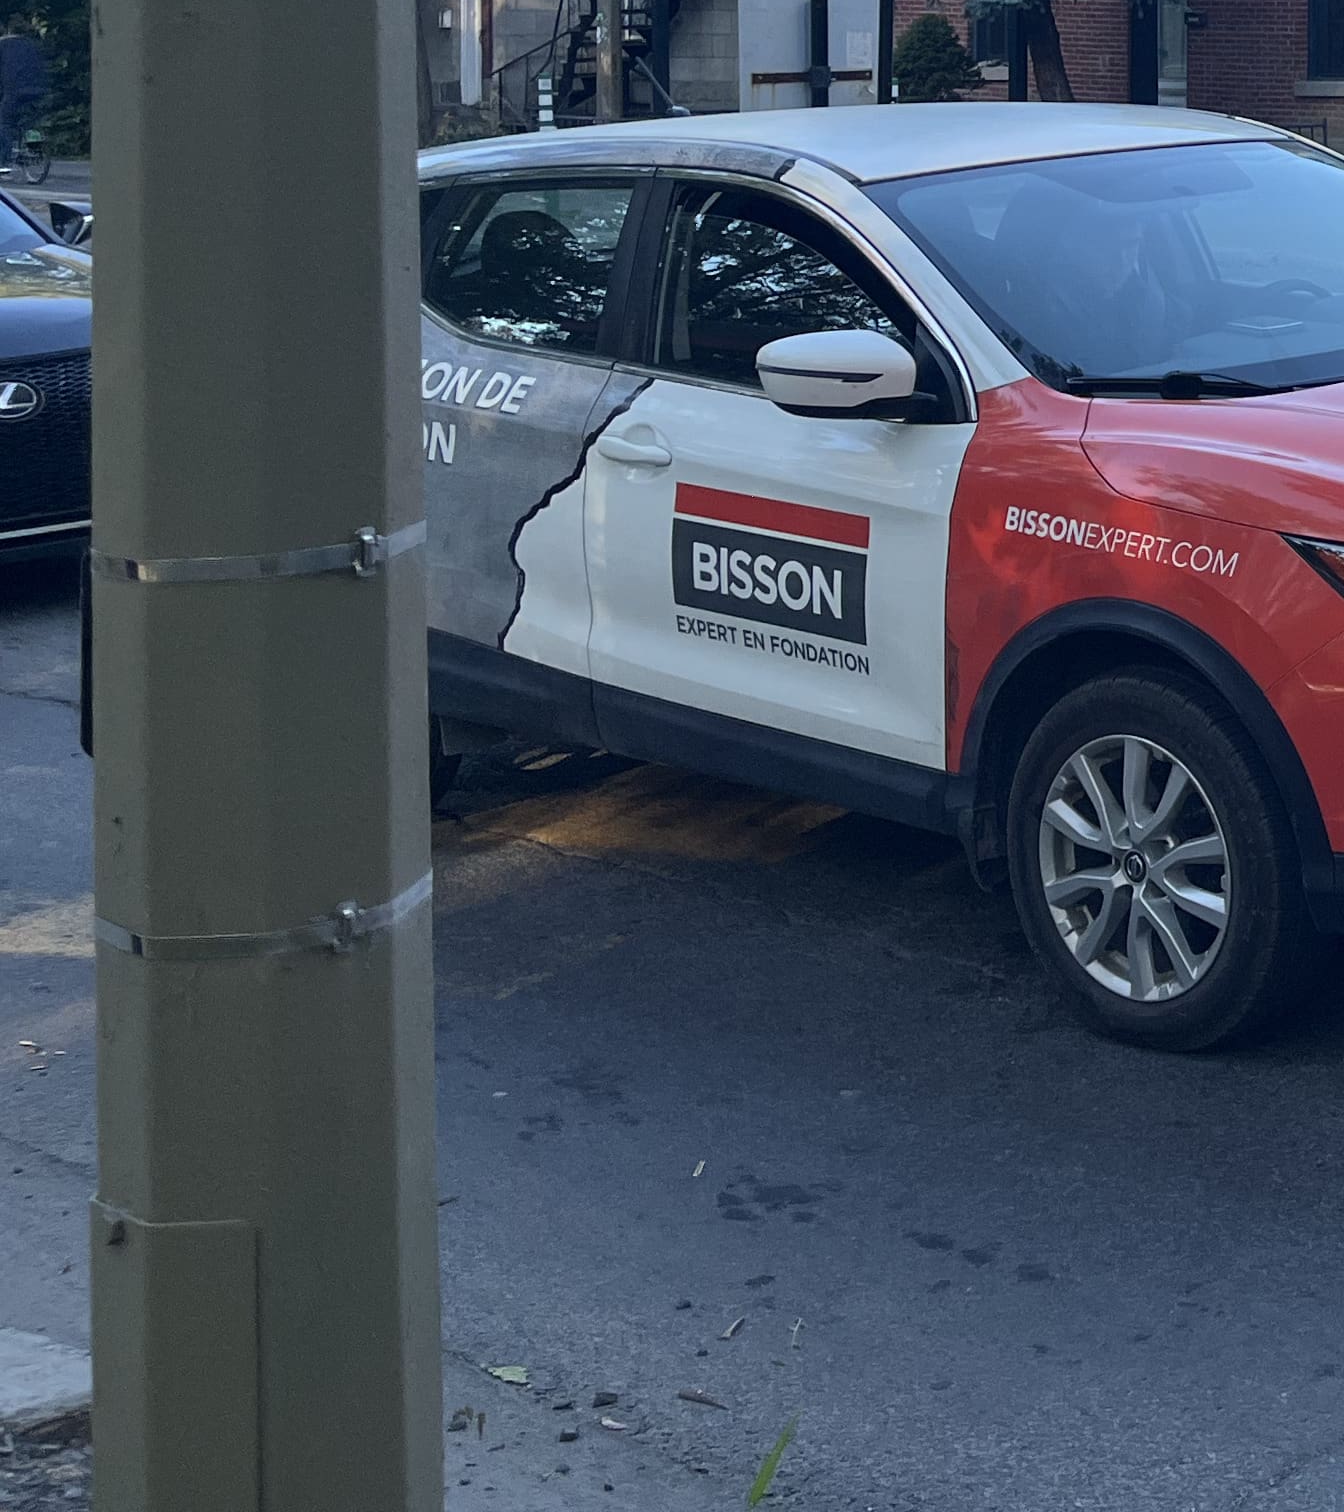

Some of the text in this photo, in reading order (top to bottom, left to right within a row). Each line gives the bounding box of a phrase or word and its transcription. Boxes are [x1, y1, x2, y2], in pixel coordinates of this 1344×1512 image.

[475, 372, 537, 414] DE
[1005, 505, 1240, 578] BISSONEXPERT.COM
[692, 541, 843, 619] BISSON
[676, 614, 870, 676] EXPERT EN FONDATION
